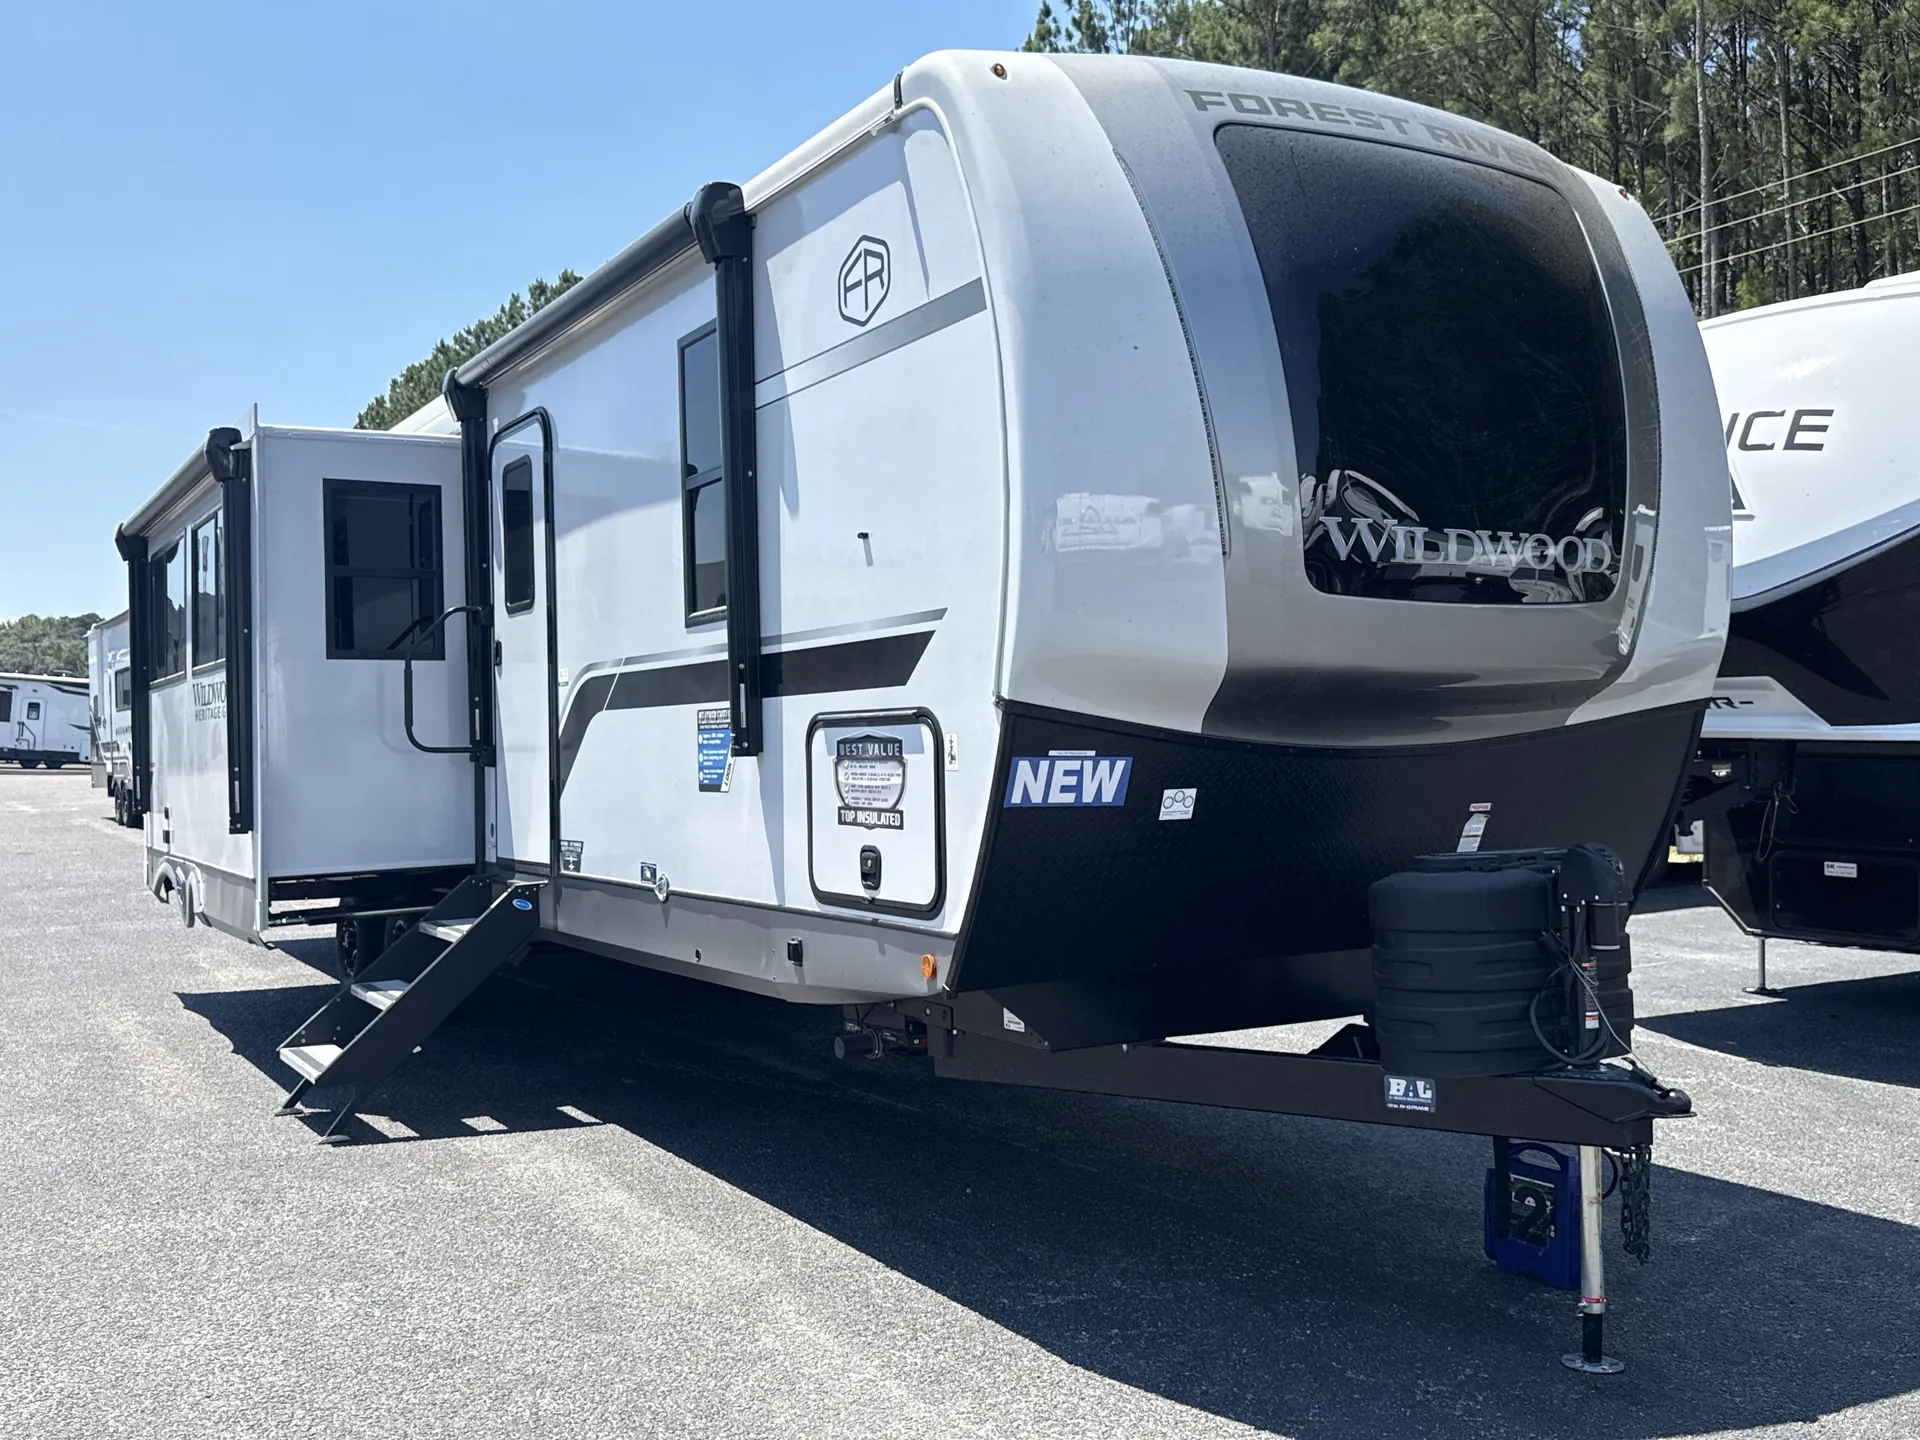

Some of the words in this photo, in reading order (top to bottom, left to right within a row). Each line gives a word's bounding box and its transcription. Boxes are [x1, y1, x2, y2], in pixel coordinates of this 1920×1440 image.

[1182, 89, 1410, 135] FOREST
[1420, 122, 1565, 181] RIVER
[1318, 515, 1613, 574] WILDWOOD
[192, 680, 227, 707] WILDWO
[839, 743, 862, 756] BEST
[867, 742, 901, 756] VALUE
[1010, 759, 1127, 804] NEW
[840, 809, 855, 823] TOP
[856, 810, 901, 827] INSULATED
